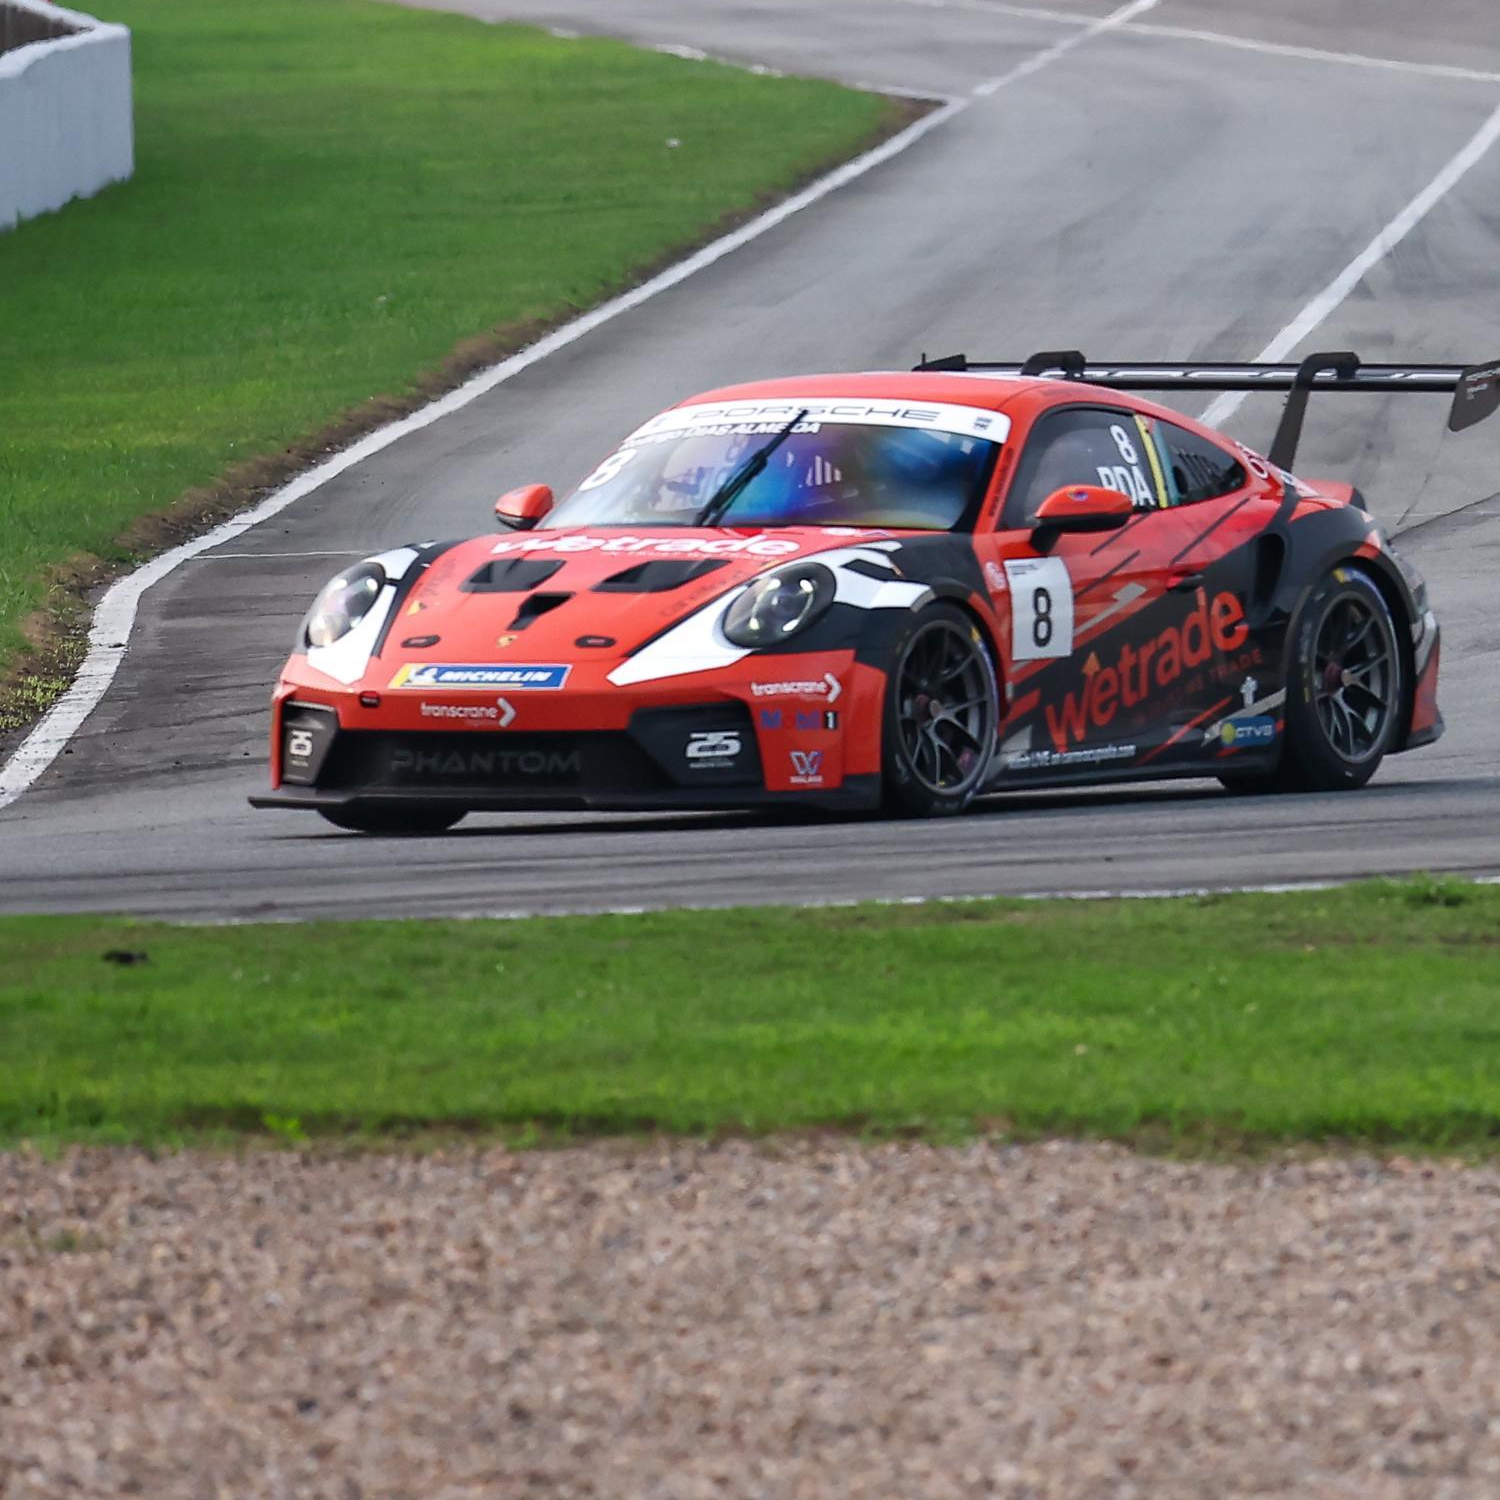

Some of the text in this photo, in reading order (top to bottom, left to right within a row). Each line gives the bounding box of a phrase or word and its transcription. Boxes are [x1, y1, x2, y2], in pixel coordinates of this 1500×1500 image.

[690, 405, 941, 422] PORSCHE
[729, 421, 821, 436] ALMEDA
[1110, 424, 1138, 465] 8
[578, 448, 638, 492] 8
[490, 533, 801, 556] wetrade
[1032, 587, 1052, 648] 8
[438, 670, 553, 682] MICHELIN
[1045, 585, 1249, 753] wetrade
[419, 701, 499, 718] transcrane
[390, 750, 583, 774] PHANTOM
